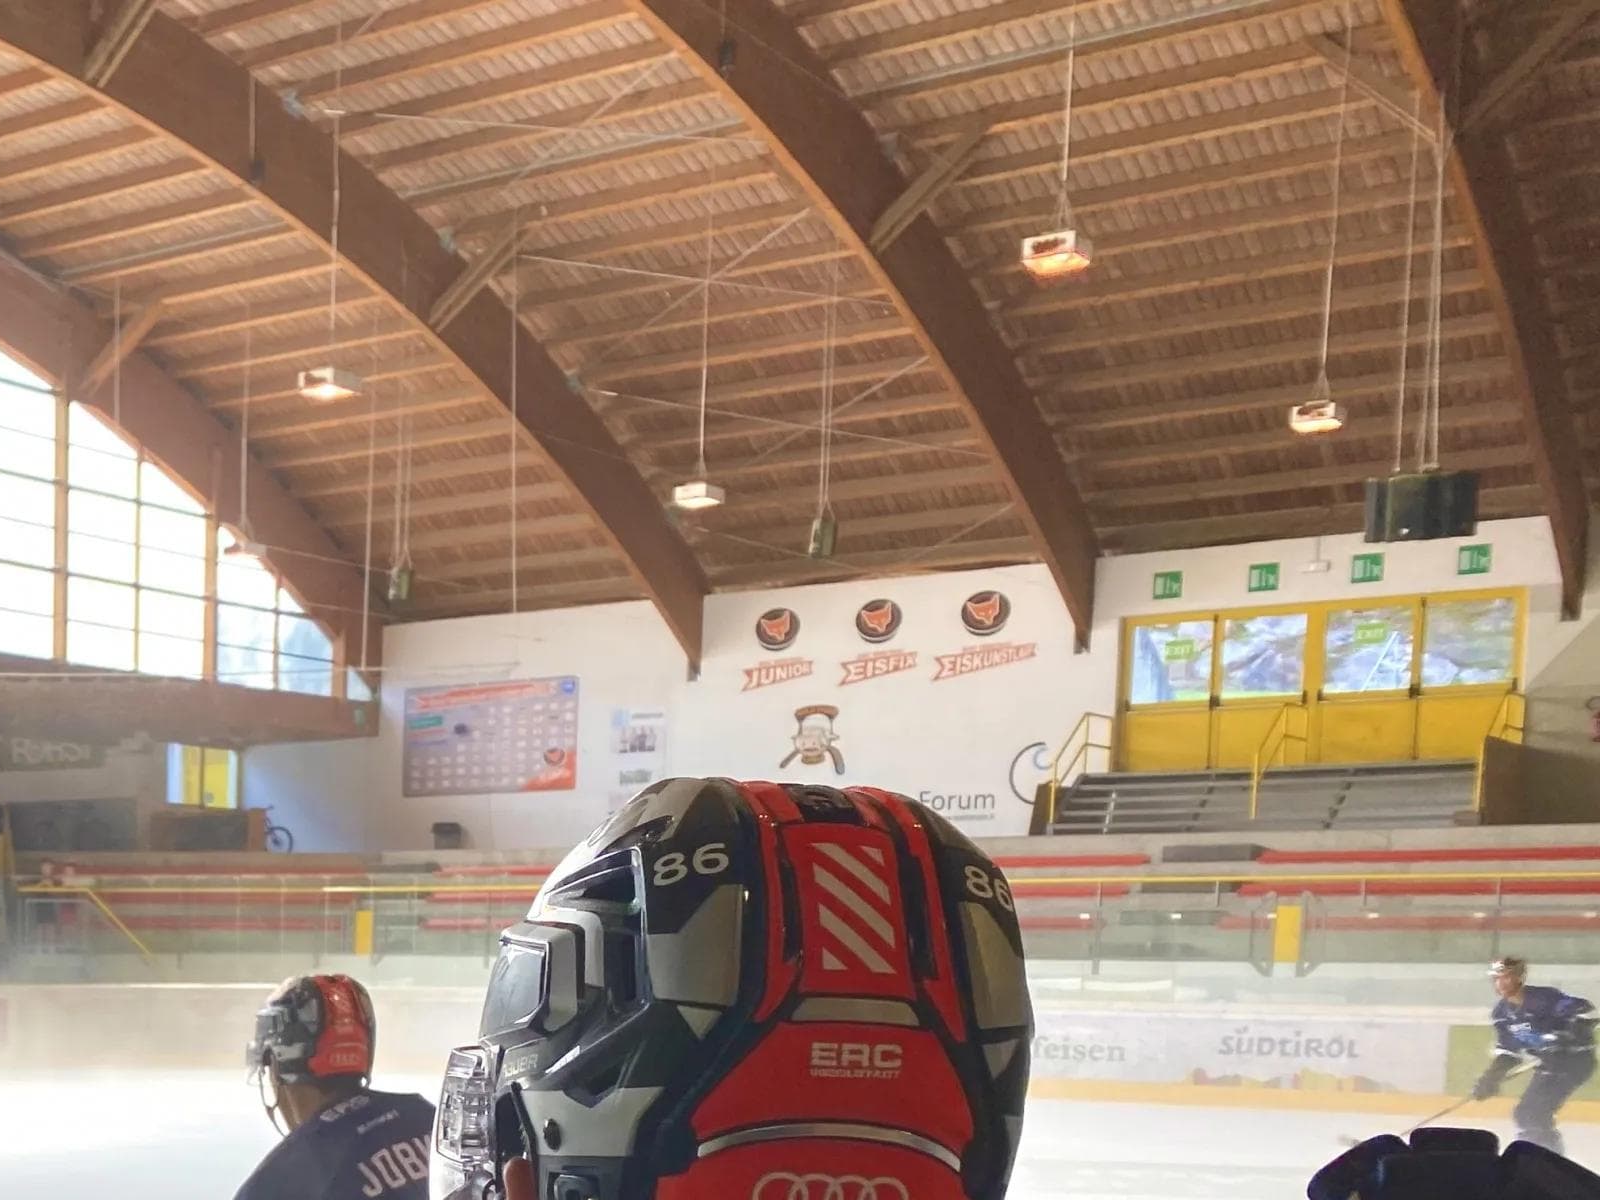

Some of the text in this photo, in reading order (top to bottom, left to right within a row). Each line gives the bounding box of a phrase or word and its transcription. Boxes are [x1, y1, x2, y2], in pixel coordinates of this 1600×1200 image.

[750, 663, 811, 687] JUNIOR
[919, 791, 996, 811] Forum
[653, 843, 730, 887] 86
[963, 865, 1014, 912] 86
